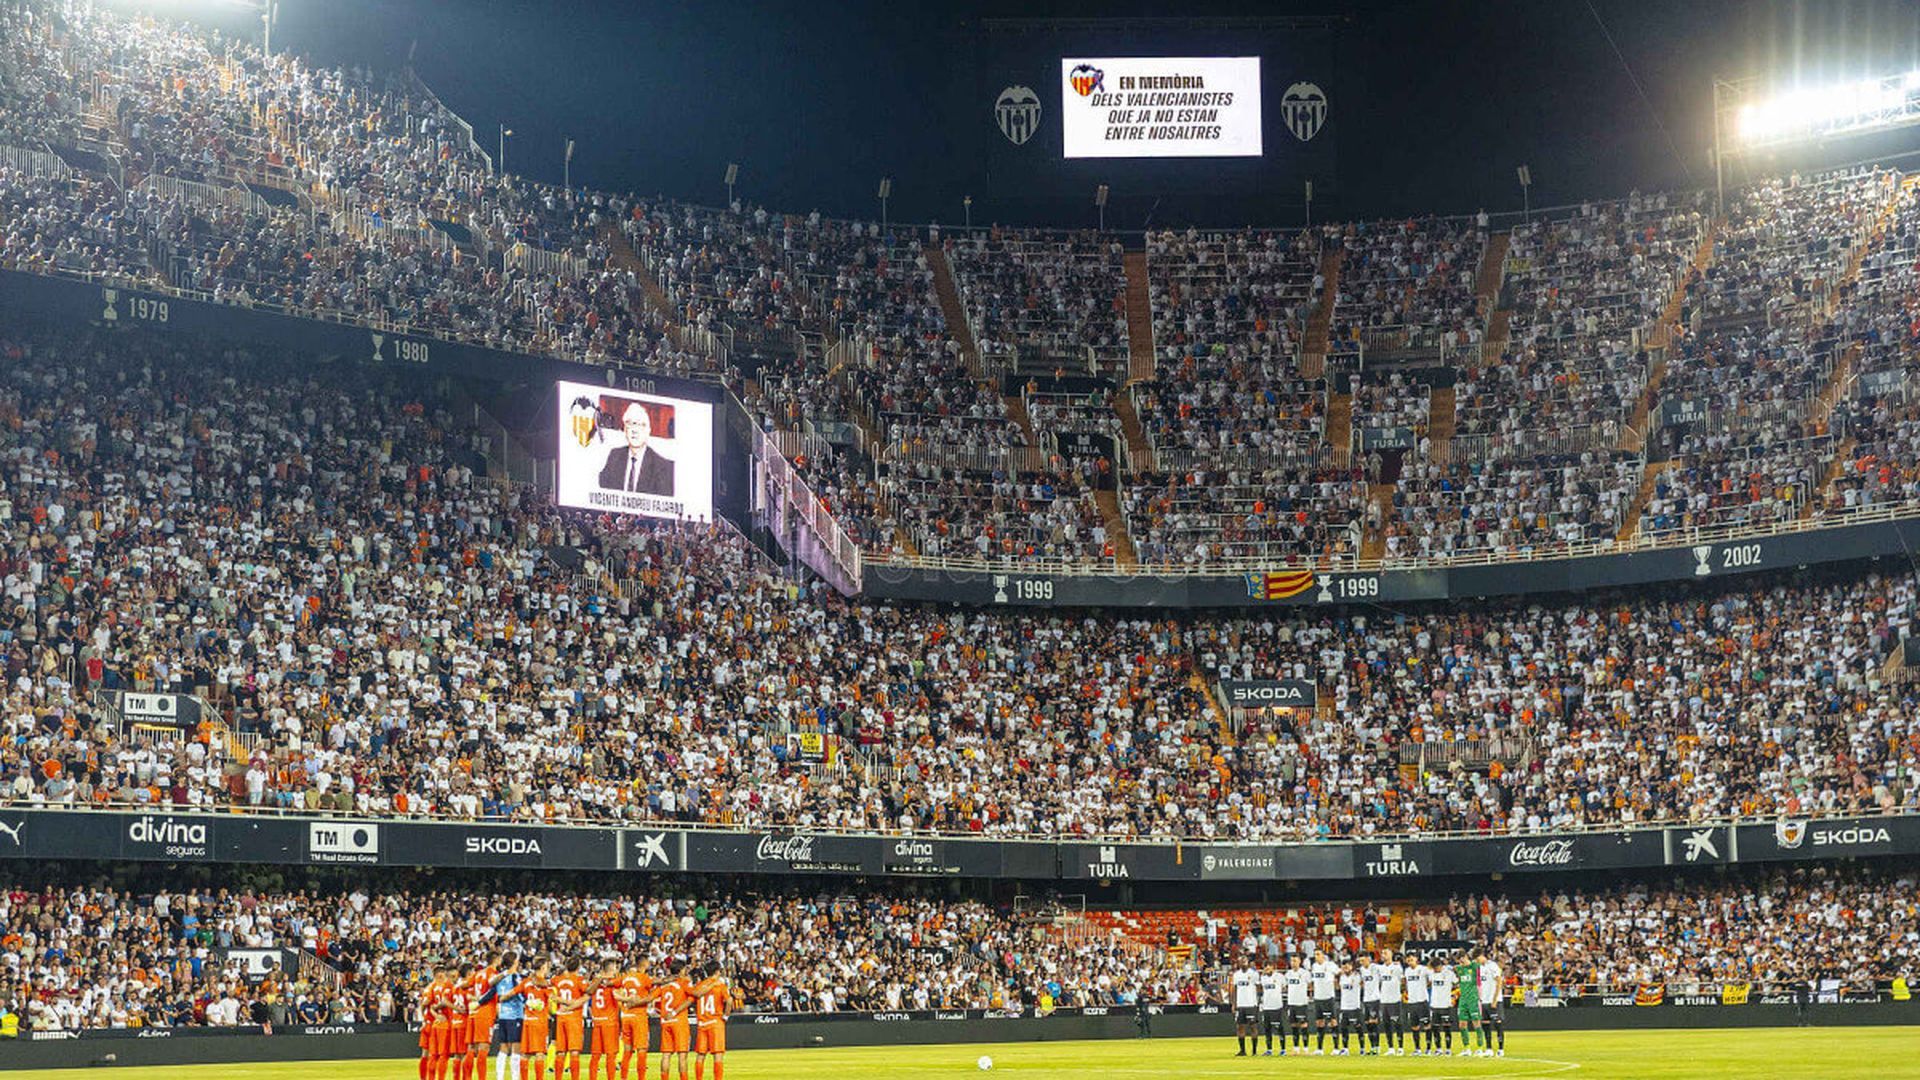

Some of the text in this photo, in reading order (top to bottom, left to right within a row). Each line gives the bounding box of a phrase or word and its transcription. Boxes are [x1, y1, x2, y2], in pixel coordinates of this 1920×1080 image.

[1119, 73, 1204, 90] EN MEMÒRIA
[1091, 92, 1234, 107] DELS VALENCIANISTES
[1108, 109, 1218, 123] QUE JA NO ESTAN
[1105, 125, 1221, 140] ENTRE NOSALTRES
[129, 297, 169, 322] 1979
[393, 339, 429, 363] 1980
[1068, 445, 1101, 454] TURIA
[1373, 438, 1406, 449] TURIA
[1723, 544, 1761, 567] 2002
[1015, 580, 1053, 599] 1999
[1339, 577, 1378, 597] 1999
[1233, 687, 1302, 699] SKODA
[128, 698, 146, 709] TM
[129, 816, 206, 844] divina
[315, 830, 338, 845] TM
[1813, 828, 1891, 845] SKODA
[166, 845, 206, 858] seguros
[466, 838, 541, 854] SKODA
[895, 839, 933, 856] divina
[1088, 863, 1129, 877] TURIA
[1366, 860, 1419, 876] TURIA
[595, 988, 605, 1008] 5
[664, 991, 673, 1011] 2
[700, 995, 716, 1015] 14
[1686, 997, 1717, 1006] TURIA
